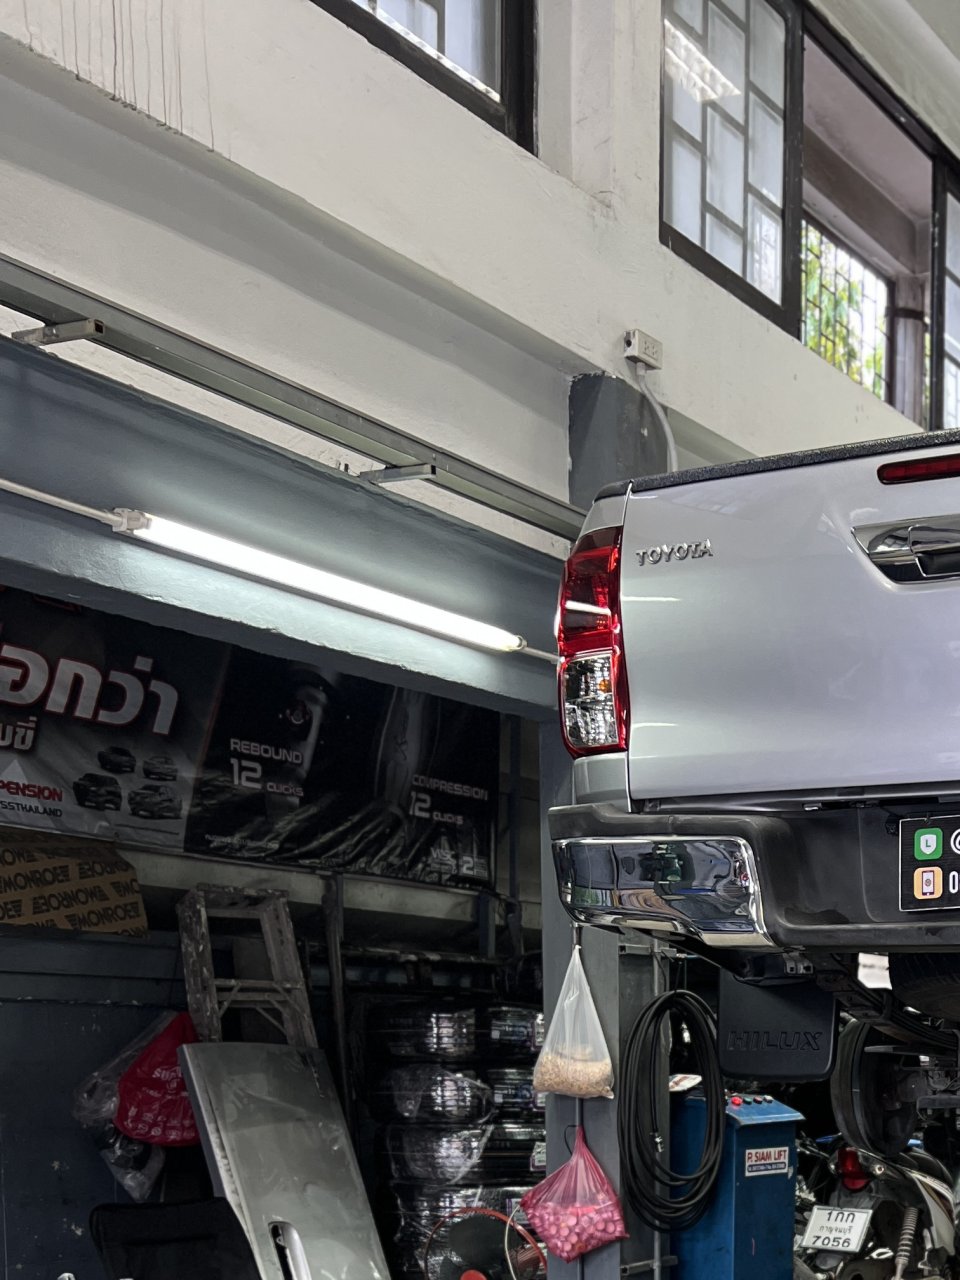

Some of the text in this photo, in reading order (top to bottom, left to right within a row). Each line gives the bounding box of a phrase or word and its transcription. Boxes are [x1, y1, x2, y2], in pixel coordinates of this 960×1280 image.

[635, 538, 714, 566] TOYOTA
[229, 738, 304, 764] REBOUND
[229, 757, 305, 797] 12 CLICKS
[411, 773, 489, 801] COMPRESSION
[408, 791, 433, 818] 12
[727, 1031, 823, 1051] HILUX
[754, 1150, 772, 1162] SIAM
[773, 1149, 787, 1161] LIFT
[827, 1210, 856, 1223] 1กก
[812, 1236, 851, 1248] 7056
